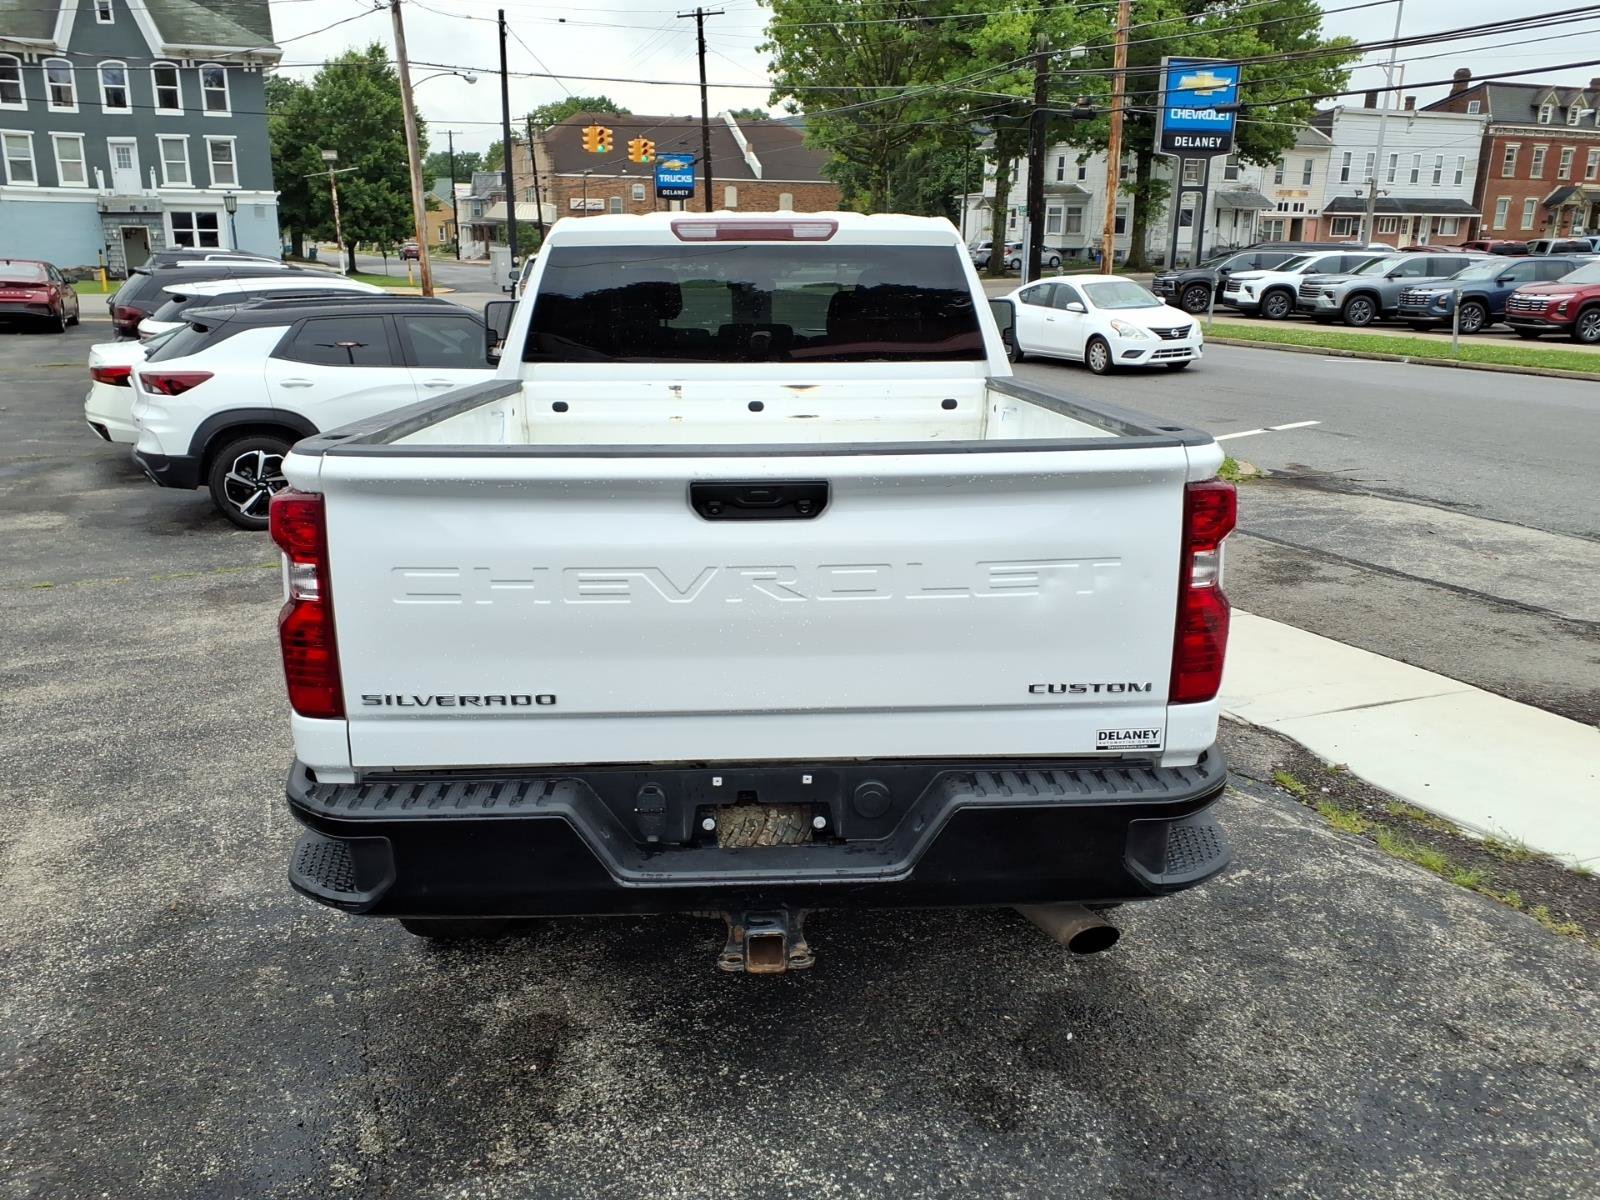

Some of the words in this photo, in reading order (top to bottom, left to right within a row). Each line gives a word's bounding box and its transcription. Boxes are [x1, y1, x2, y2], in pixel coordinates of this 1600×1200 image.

[1170, 108, 1230, 121] CHEVROLET
[1174, 136, 1222, 148] DELANEY
[659, 174, 693, 183] TRUCKS
[391, 557, 1122, 603] CHEVROLET
[1028, 682, 1152, 694] CUSTOM
[361, 694, 558, 707] SILVERADO
[1098, 730, 1160, 741] DELANEY
